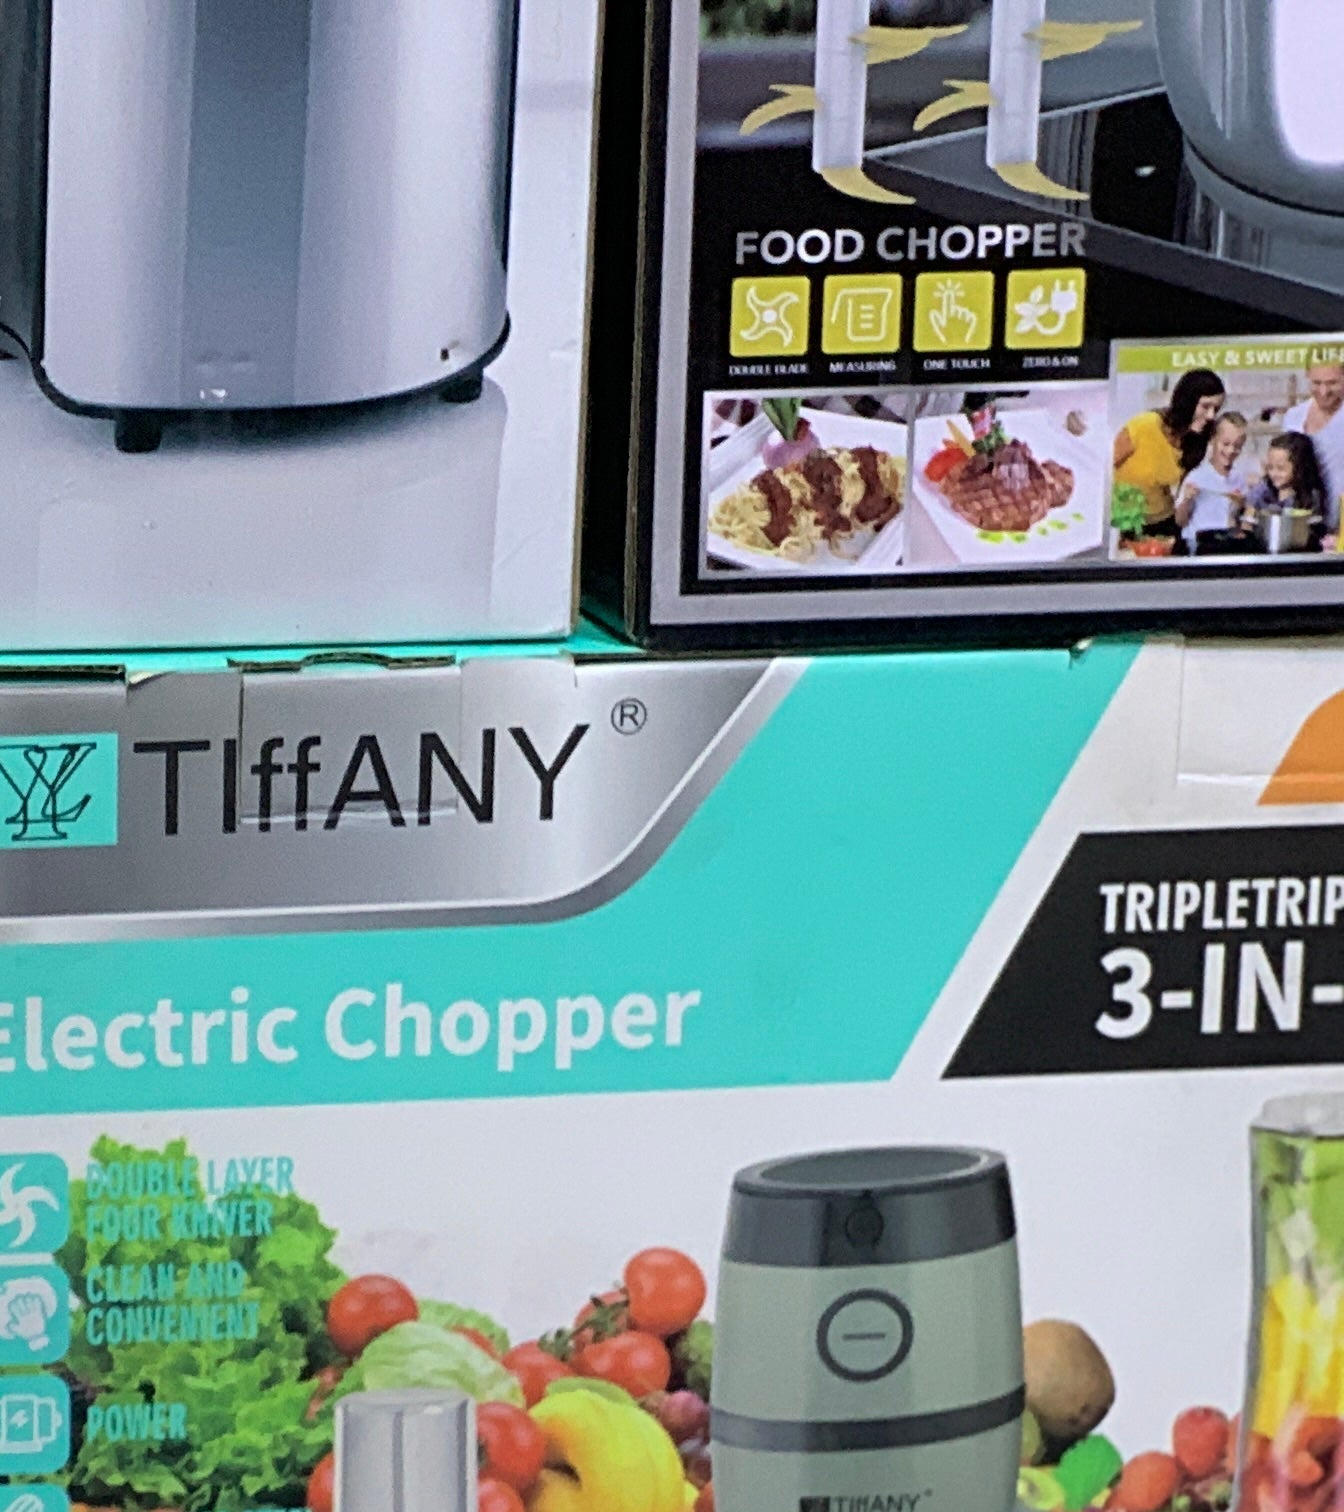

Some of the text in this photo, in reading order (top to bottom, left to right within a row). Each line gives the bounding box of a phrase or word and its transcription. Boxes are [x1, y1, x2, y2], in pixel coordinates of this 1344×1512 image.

[735, 222, 1086, 265] FOOD CHOPPER
[1172, 351, 1220, 367] EASY
[1224, 350, 1239, 365] &
[1245, 348, 1307, 365] SWEET
[1095, 940, 1344, 1040] 3-IN-
[324, 982, 702, 1071] Chopper
[86, 1156, 294, 1199] DOUBLE LAYER
[86, 1203, 160, 1242] FOUR
[86, 1260, 246, 1303] CLEAN AND
[86, 1302, 259, 1345] CONVENIENT
[86, 1403, 187, 1442] POWER
